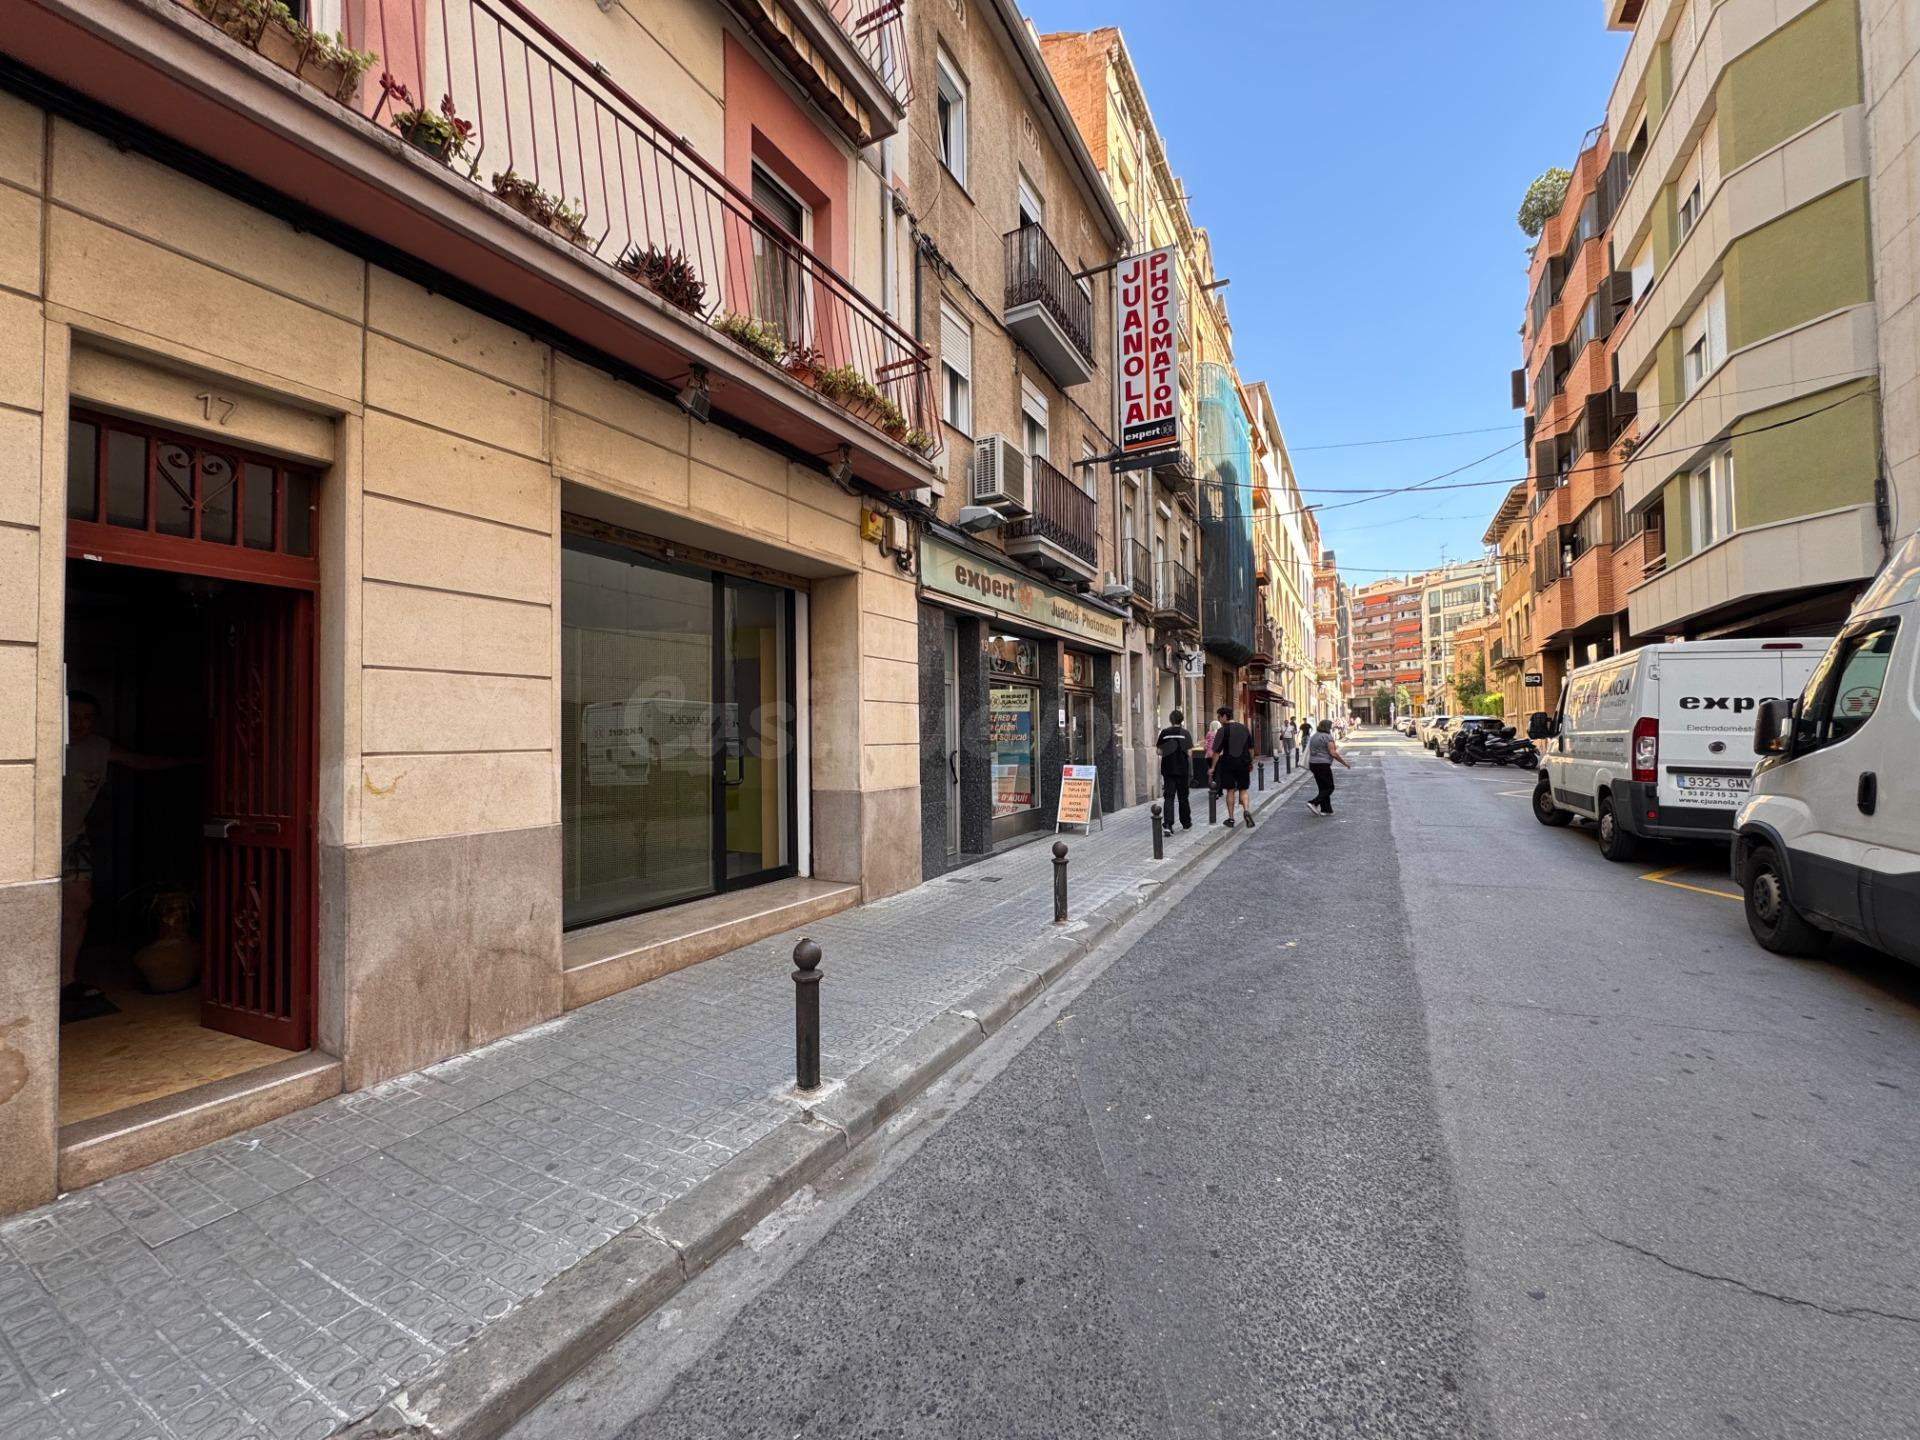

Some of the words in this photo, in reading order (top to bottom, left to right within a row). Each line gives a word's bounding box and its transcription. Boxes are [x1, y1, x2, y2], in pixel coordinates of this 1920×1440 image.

[1121, 261, 1145, 425] JUANOLA
[1149, 252, 1172, 419] PHOTOMATON
[196, 392, 237, 426] 17
[1125, 427, 1161, 441] expert
[955, 563, 1015, 603] expert
[1051, 601, 1079, 625] Juanola
[1082, 612, 1117, 638] Photomaton
[1688, 776, 1721, 788] 9325
[1679, 798, 1744, 806] www.cjuanola.c
